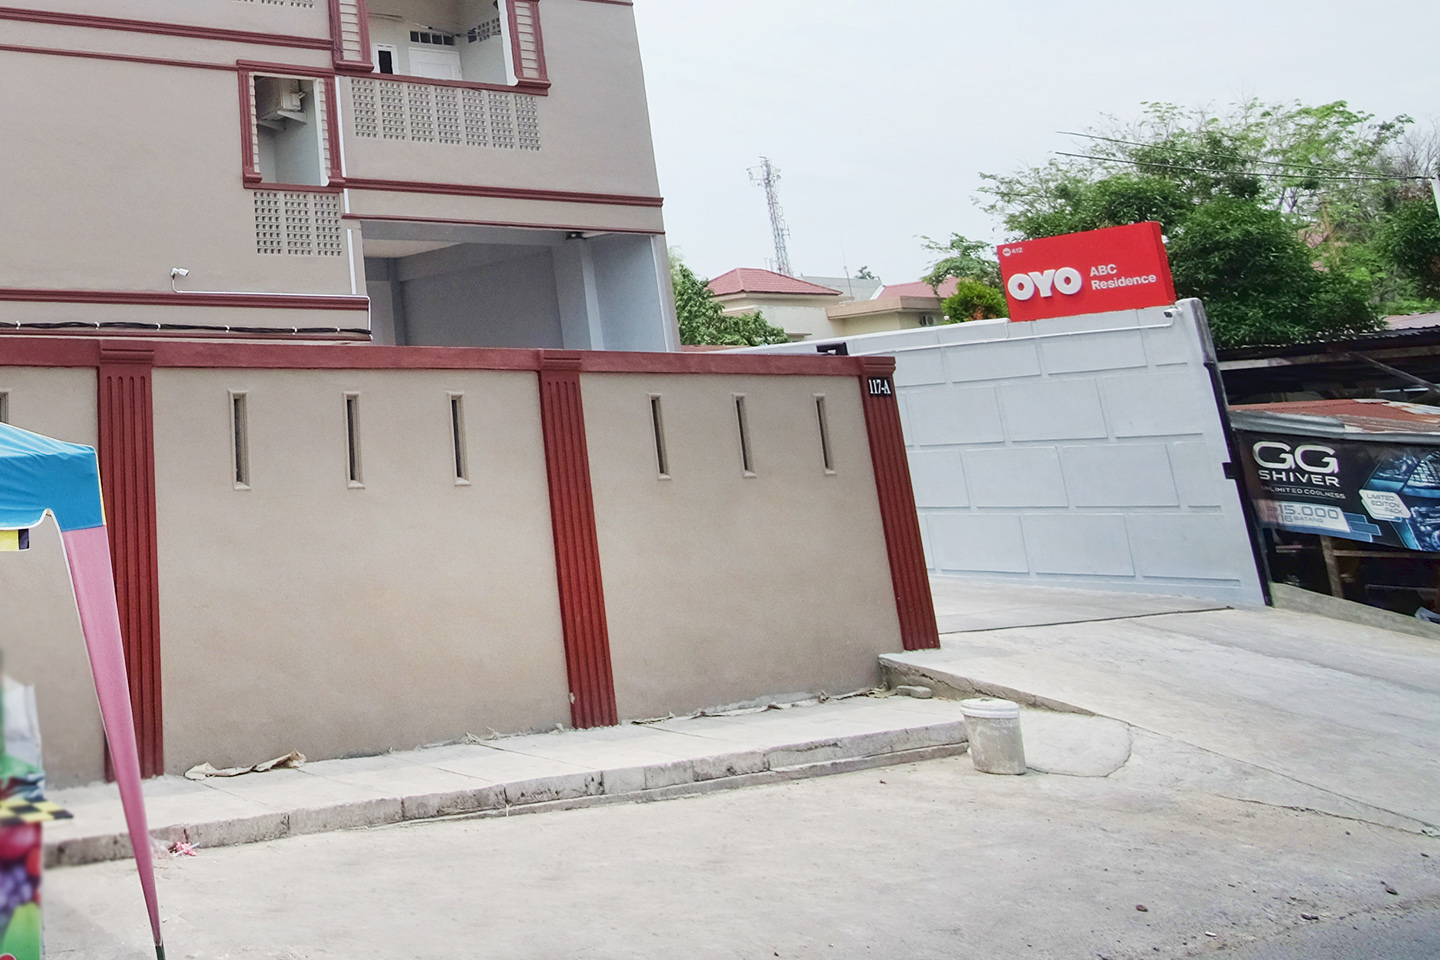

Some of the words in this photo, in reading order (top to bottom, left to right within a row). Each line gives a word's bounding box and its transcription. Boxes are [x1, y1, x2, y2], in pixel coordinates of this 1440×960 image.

[1090, 263, 1117, 278] ABC
[1007, 266, 1083, 301] OYO
[1091, 274, 1157, 291] Residence
[868, 379, 891, 394] 117-A
[1252, 441, 1340, 474] GG
[1258, 469, 1341, 488] SHIVER
[1303, 488, 1346, 499] COOLNESS
[1366, 493, 1395, 501] LIMITED
[1371, 500, 1400, 508] EDITION
[1384, 507, 1404, 515] PACK
[1278, 504, 1339, 520] 15.000
